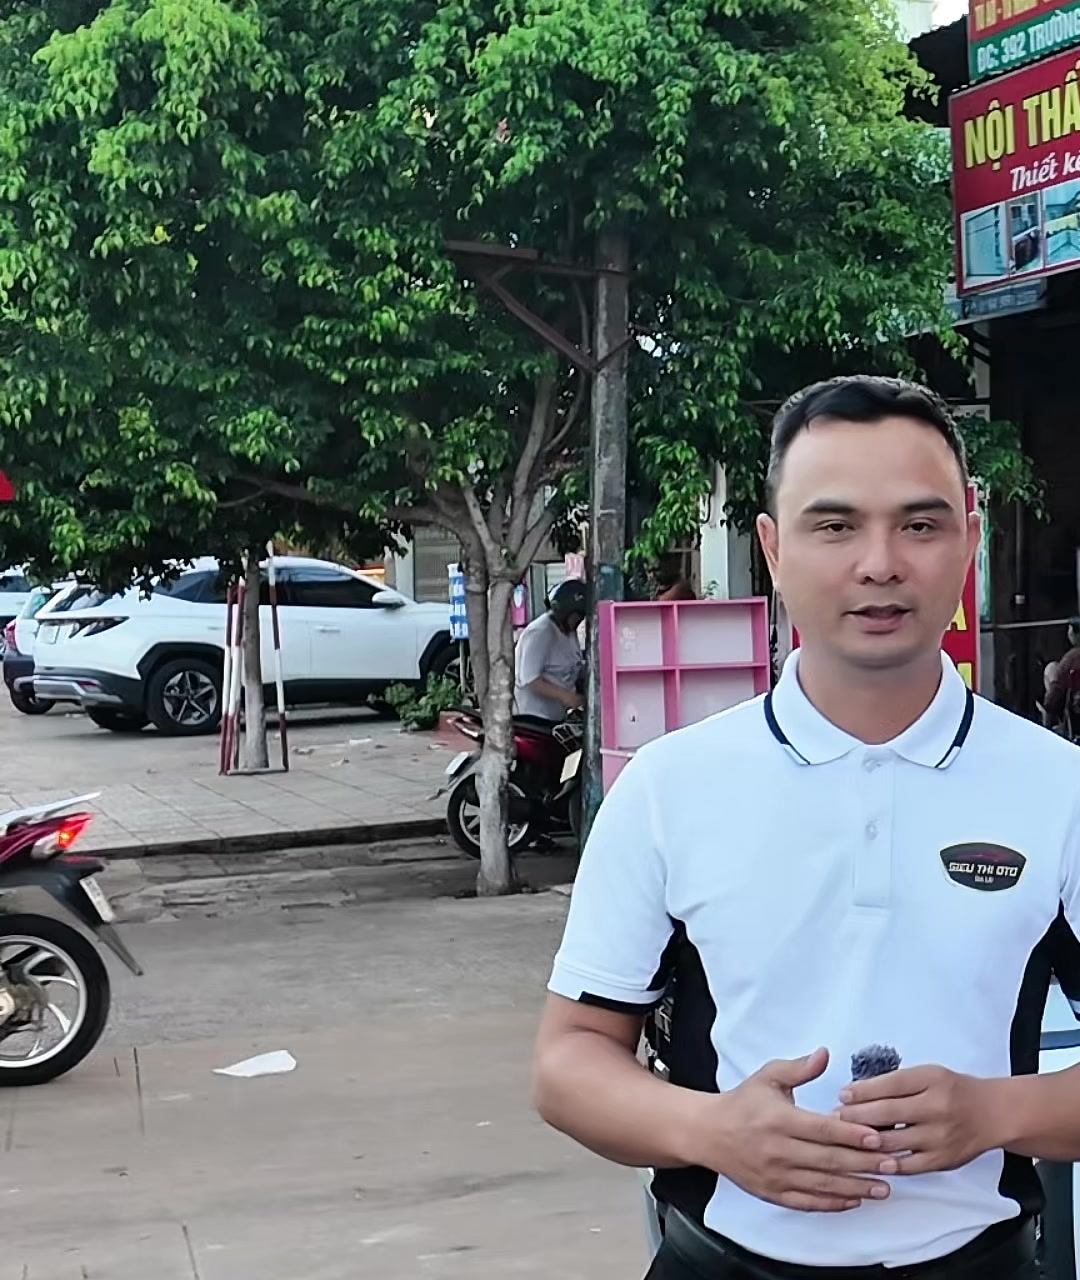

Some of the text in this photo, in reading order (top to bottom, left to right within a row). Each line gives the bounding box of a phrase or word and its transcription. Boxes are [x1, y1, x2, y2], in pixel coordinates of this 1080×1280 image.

[1001, 31, 1026, 63] 392
[963, 99, 1015, 172] NỘI
[1010, 156, 1059, 192] Thiết
